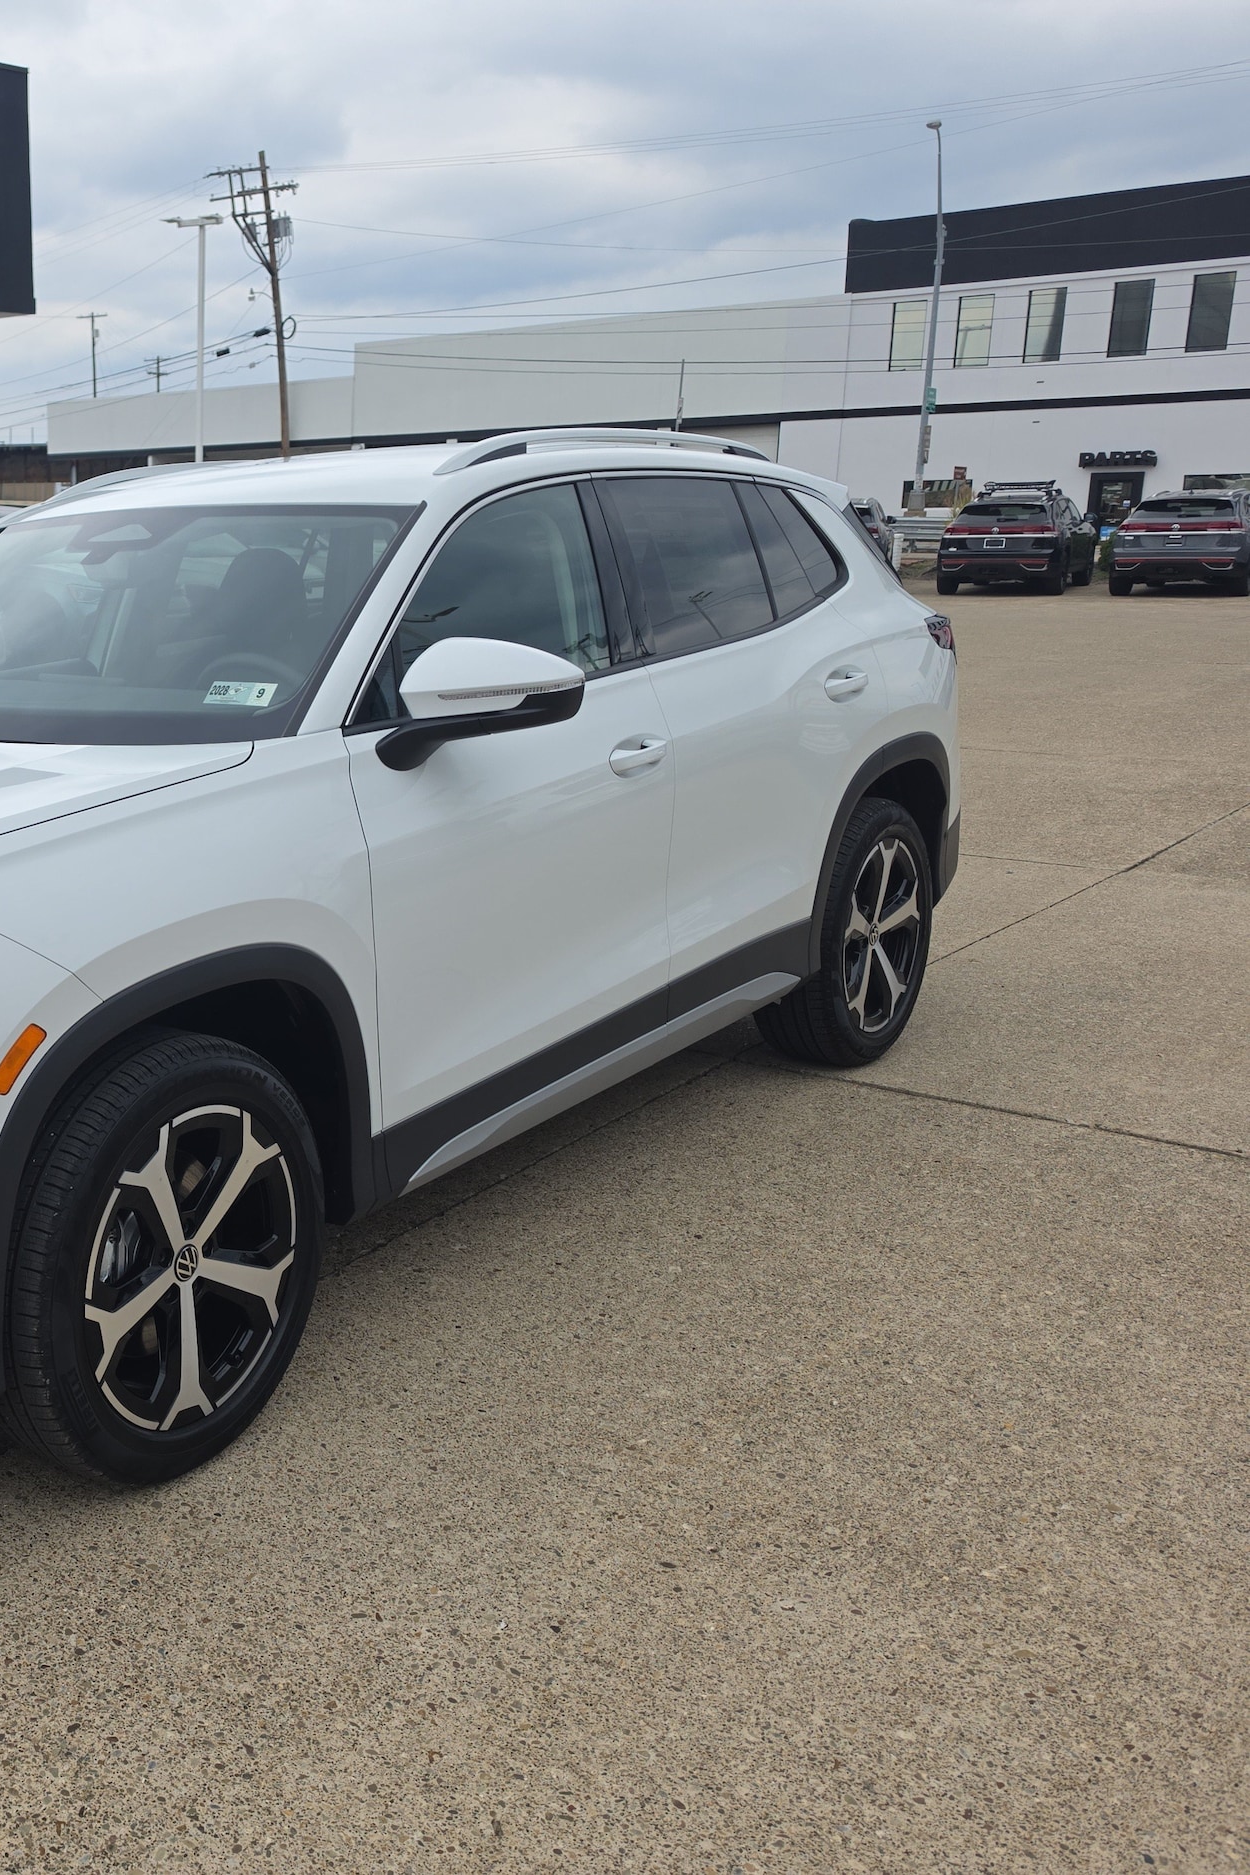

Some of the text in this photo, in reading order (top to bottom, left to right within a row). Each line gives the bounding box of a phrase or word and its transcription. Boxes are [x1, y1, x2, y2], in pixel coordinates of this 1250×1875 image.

[1078, 450, 1158, 468] PARTS
[209, 685, 266, 698] 2028 9
